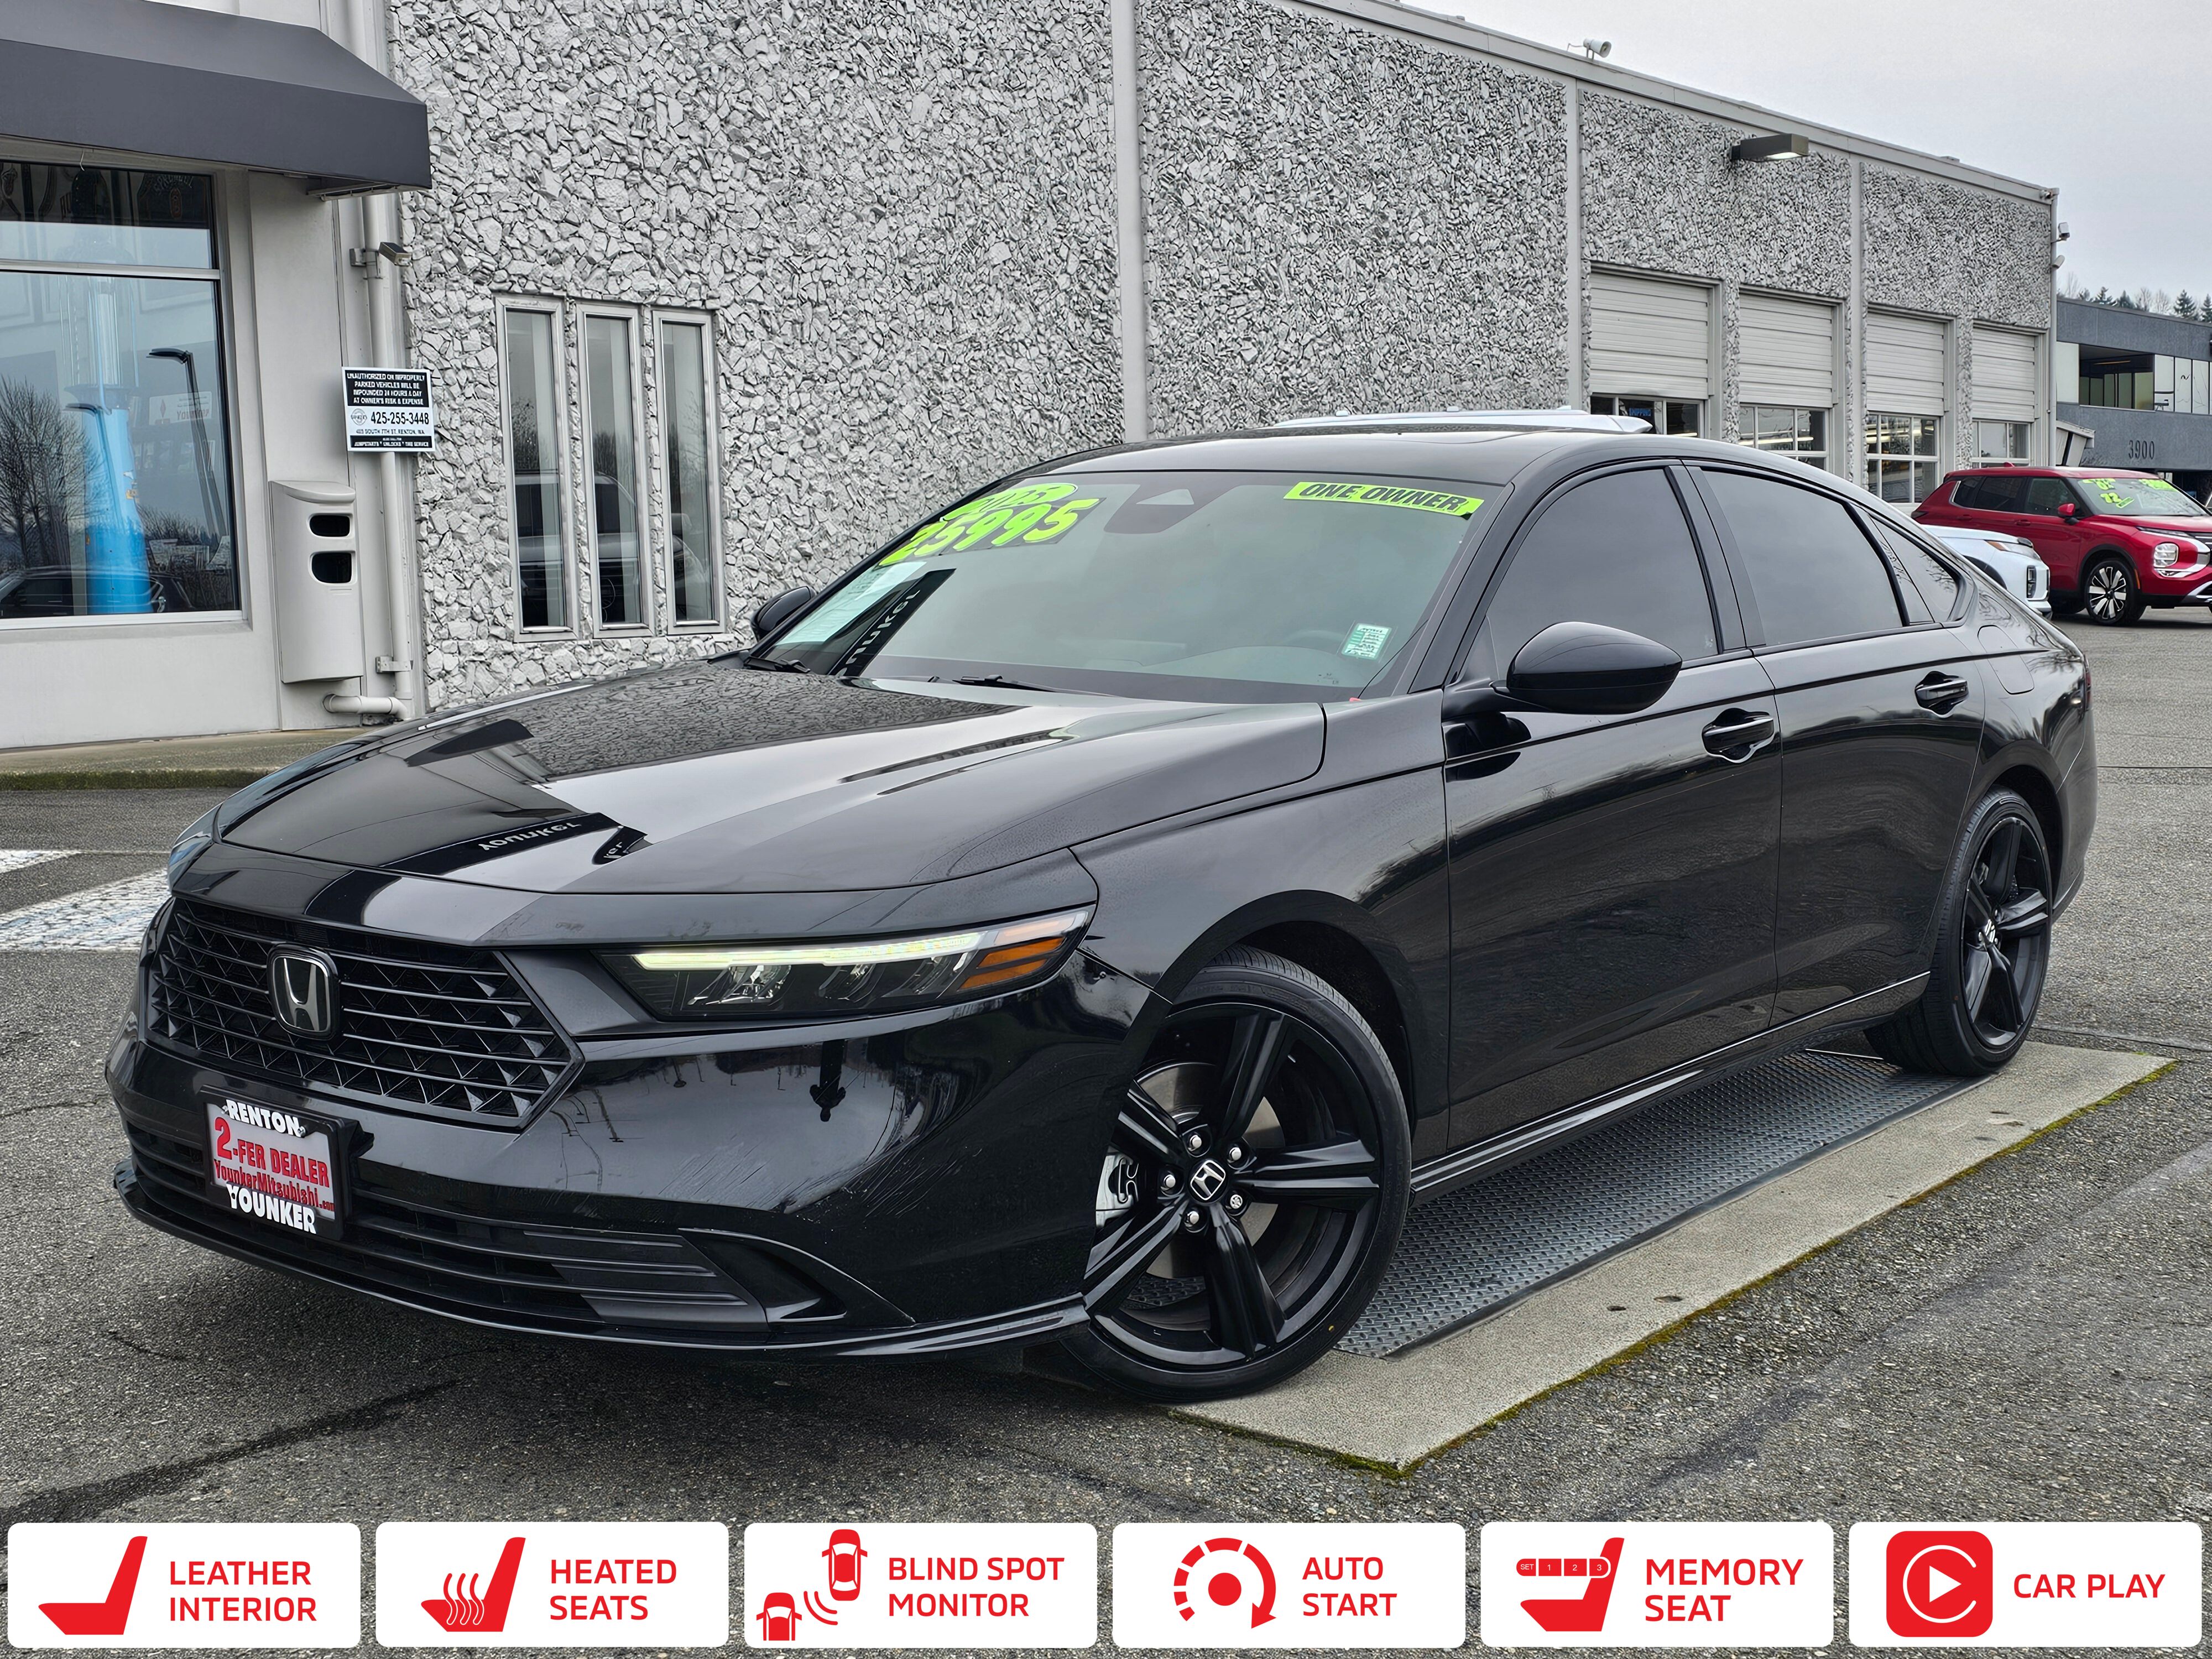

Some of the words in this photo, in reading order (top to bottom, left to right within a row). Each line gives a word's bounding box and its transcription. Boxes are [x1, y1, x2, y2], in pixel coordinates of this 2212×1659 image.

[371, 411, 430, 425] 425-255-3448
[2128, 440, 2155, 460] 3900
[1298, 483, 1365, 499] ONE
[1359, 487, 1470, 512] OWNER
[226, 1099, 302, 1138] RENTON
[215, 1117, 266, 1170] 2-FER
[269, 1147, 330, 1188] DEALER
[226, 1182, 317, 1234] YOUNKER
